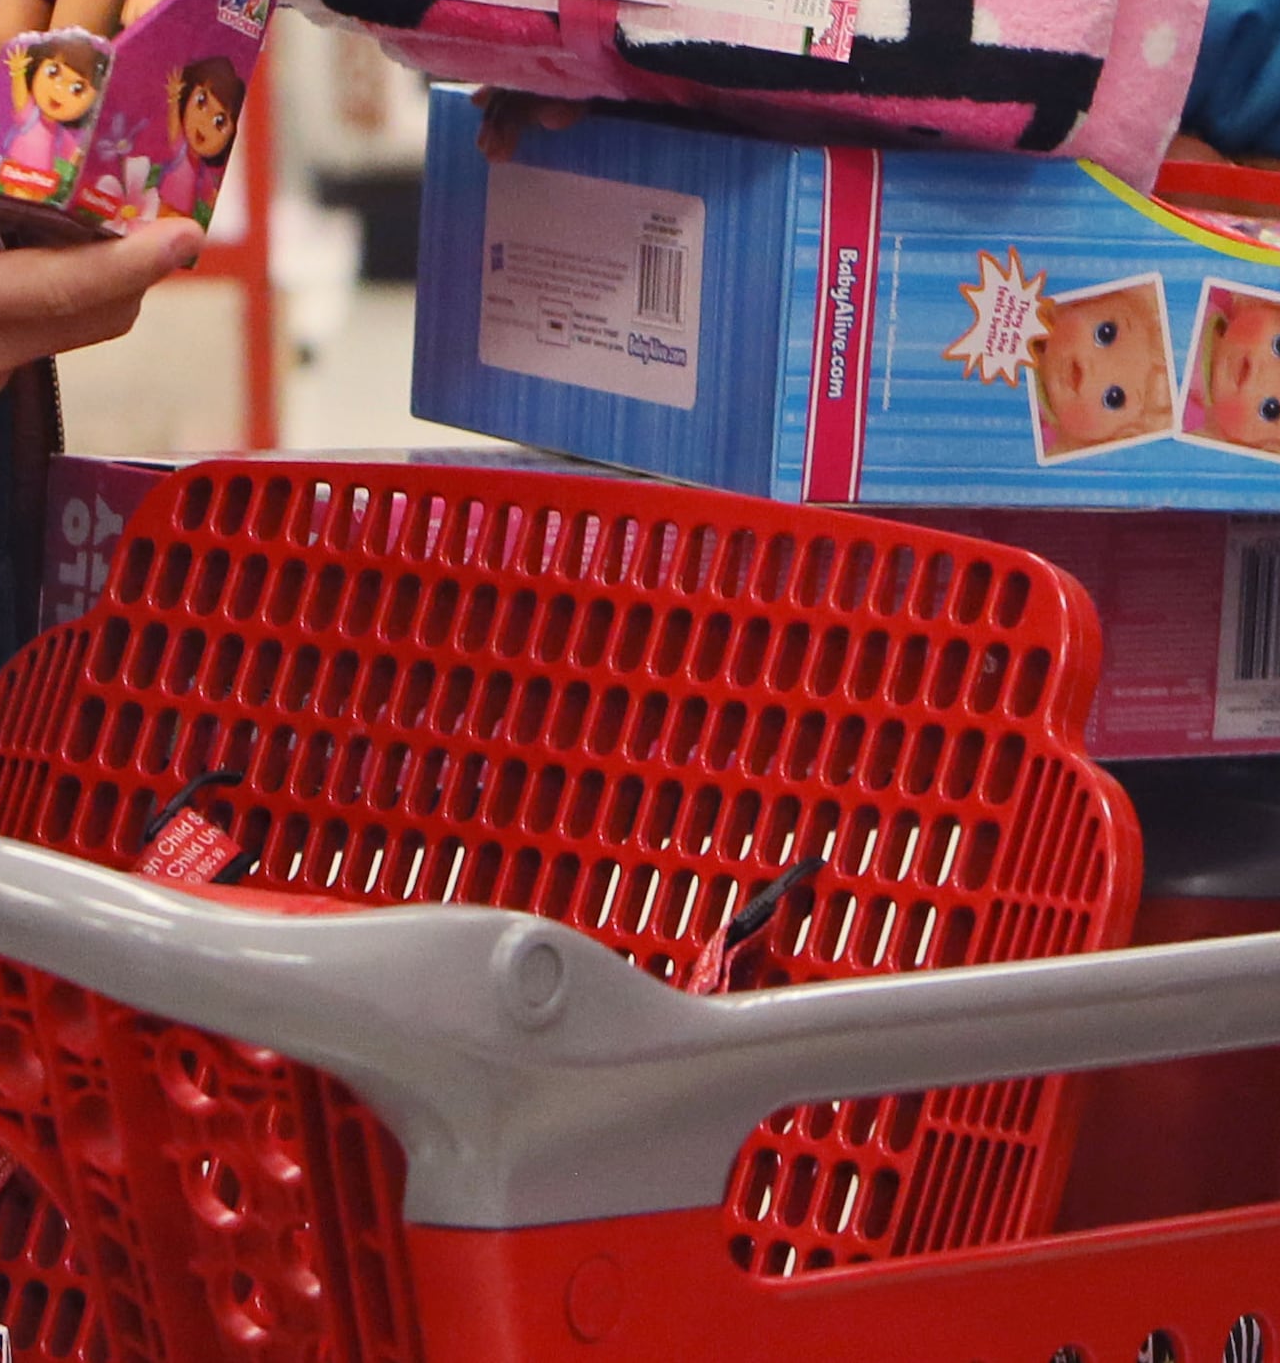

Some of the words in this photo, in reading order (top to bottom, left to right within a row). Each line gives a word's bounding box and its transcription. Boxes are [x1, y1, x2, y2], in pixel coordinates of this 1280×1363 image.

[994, 285, 1010, 314] feels
[1002, 295, 1017, 328] when
[828, 248, 859, 399] BabyAlive.com
[57, 497, 91, 624] LLO
[157, 819, 195, 855] Child
[166, 840, 205, 877] Child
